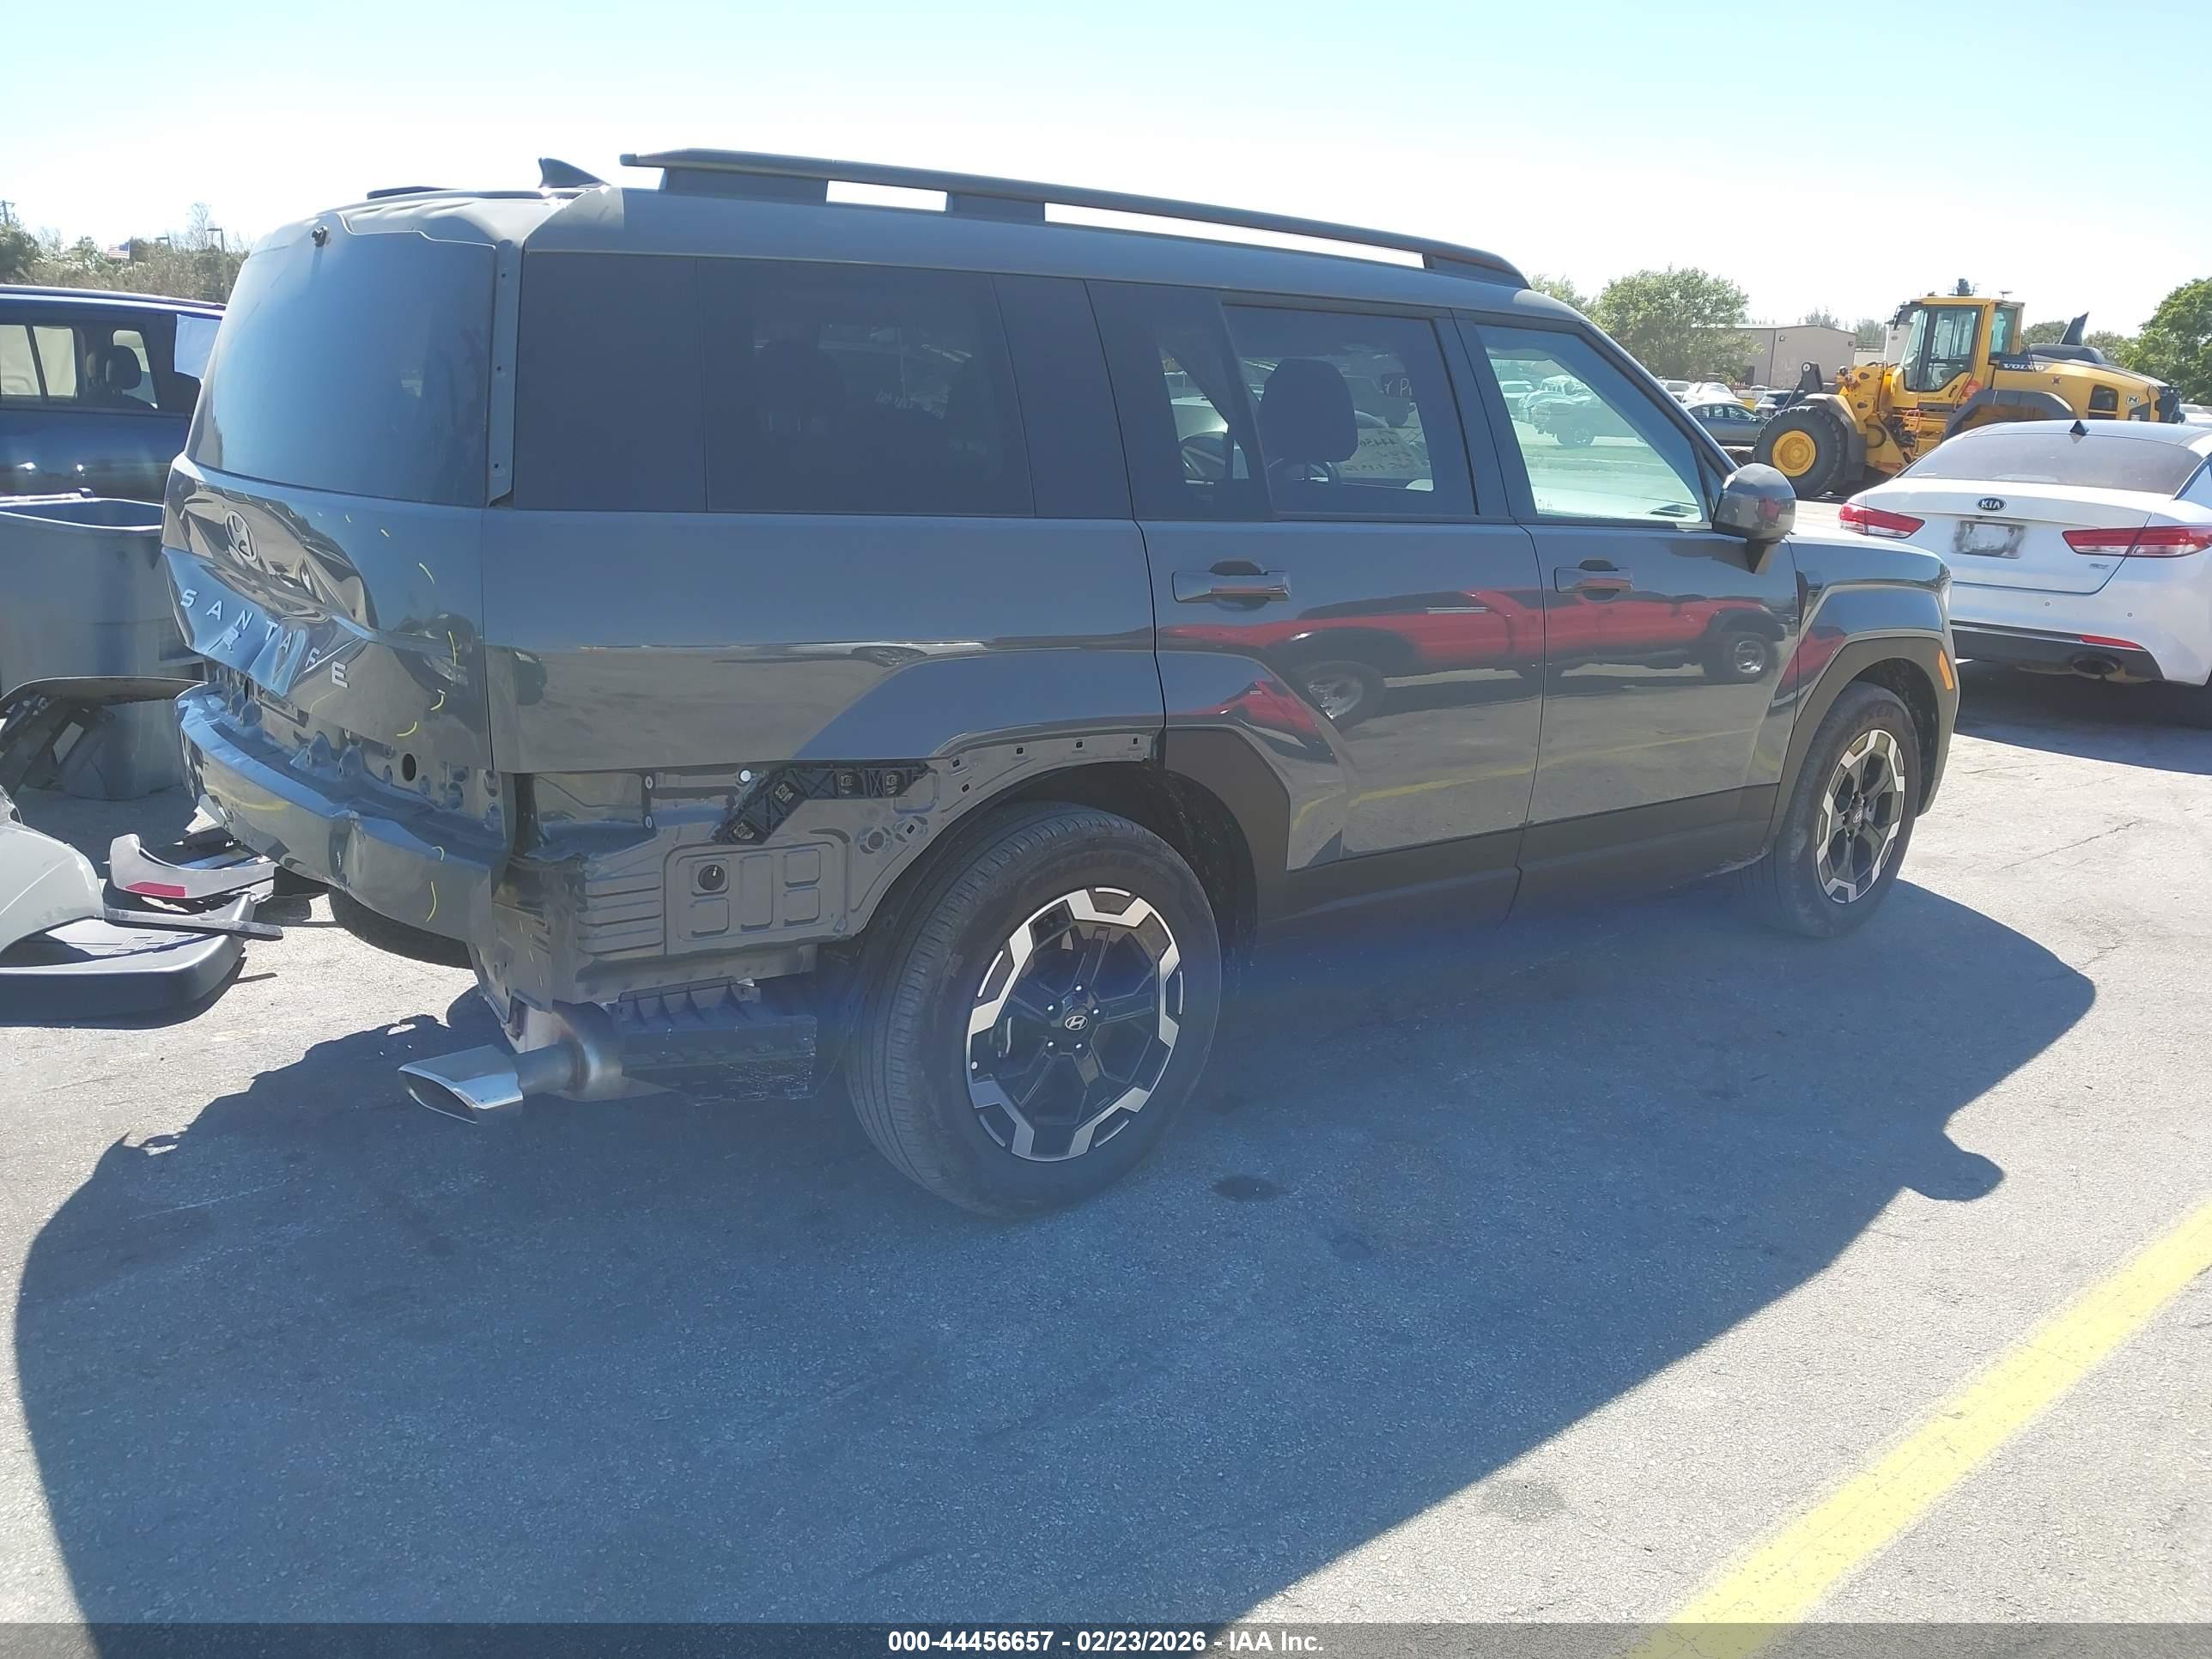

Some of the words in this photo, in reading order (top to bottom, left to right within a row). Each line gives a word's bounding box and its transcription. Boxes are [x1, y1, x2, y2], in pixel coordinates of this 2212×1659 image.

[2003, 362, 2045, 371] VOLVO
[1981, 500, 2001, 509] KIA
[179, 588, 294, 653] SANTA
[305, 647, 350, 689] FE
